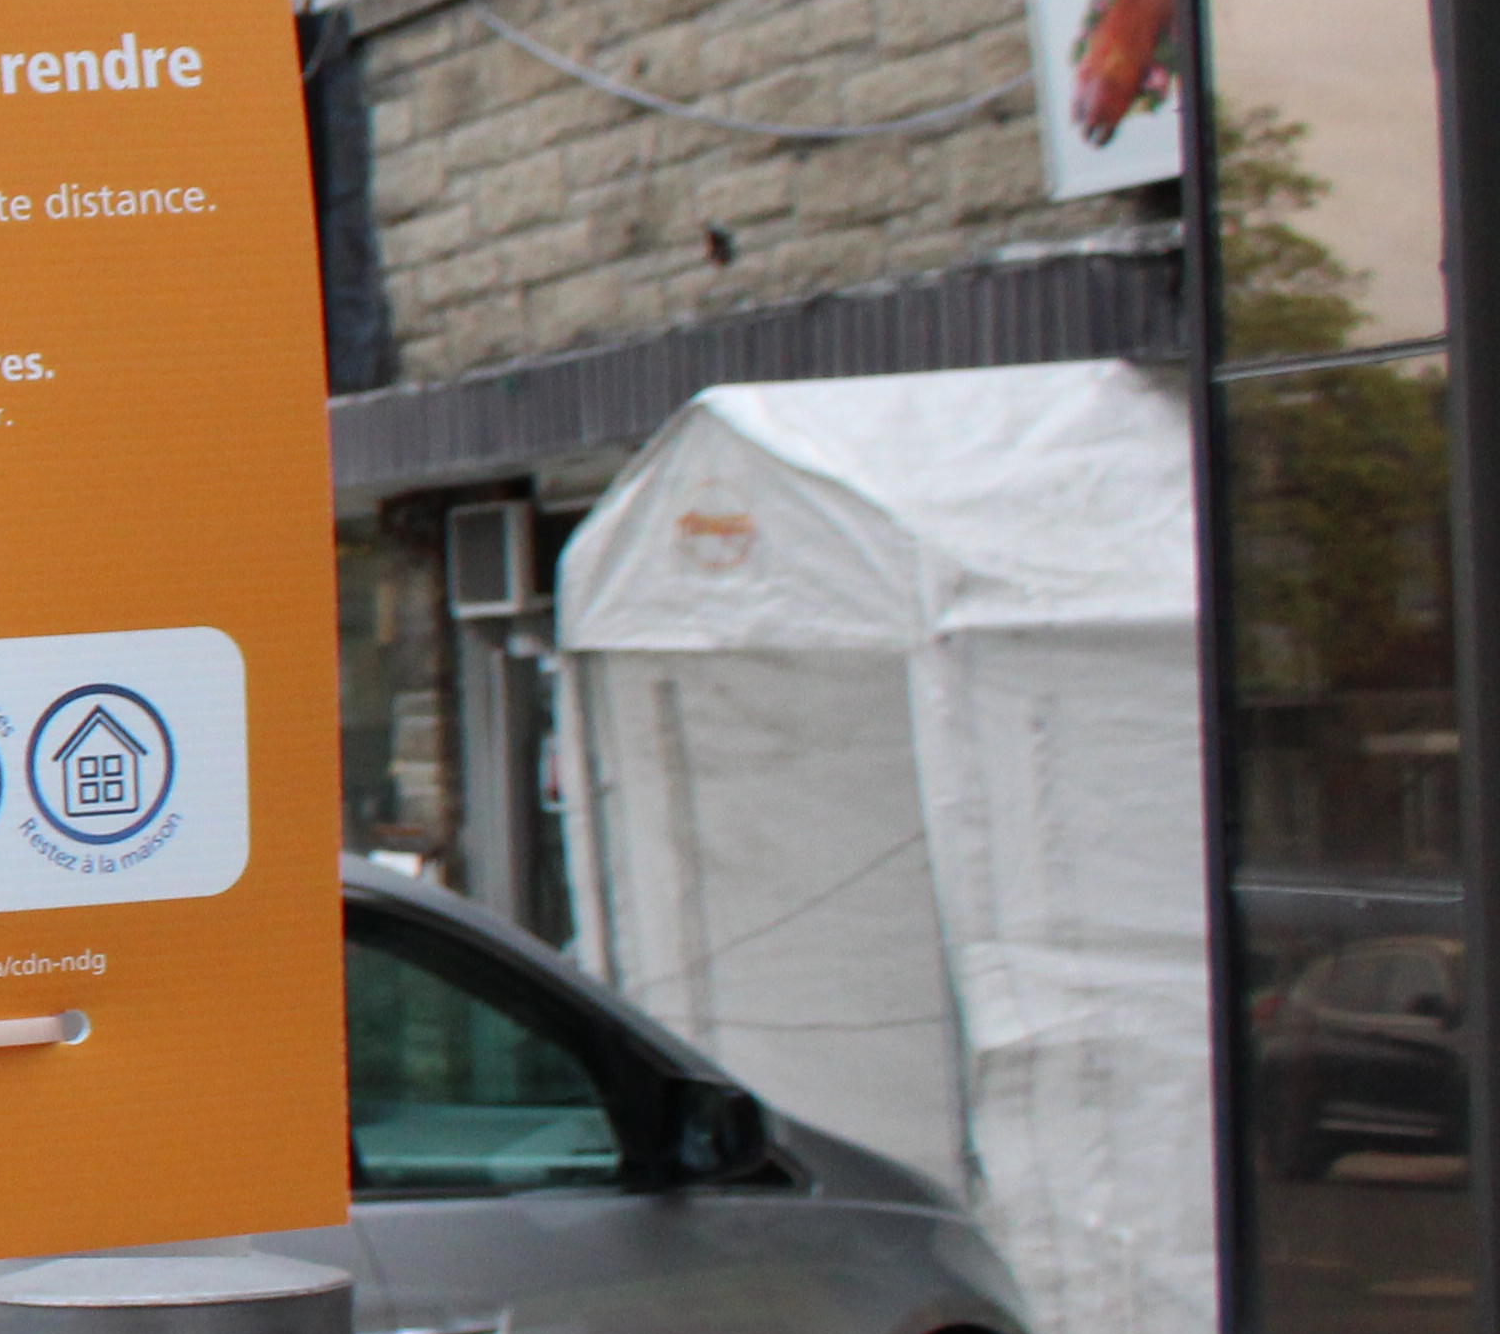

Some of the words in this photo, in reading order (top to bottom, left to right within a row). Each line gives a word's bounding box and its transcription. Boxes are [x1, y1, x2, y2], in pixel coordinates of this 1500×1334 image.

[44, 184, 216, 220] distance.
[19, 816, 75, 870] Restez
[82, 853, 94, 874] à
[100, 853, 115, 874] la
[119, 811, 183, 869] maison
